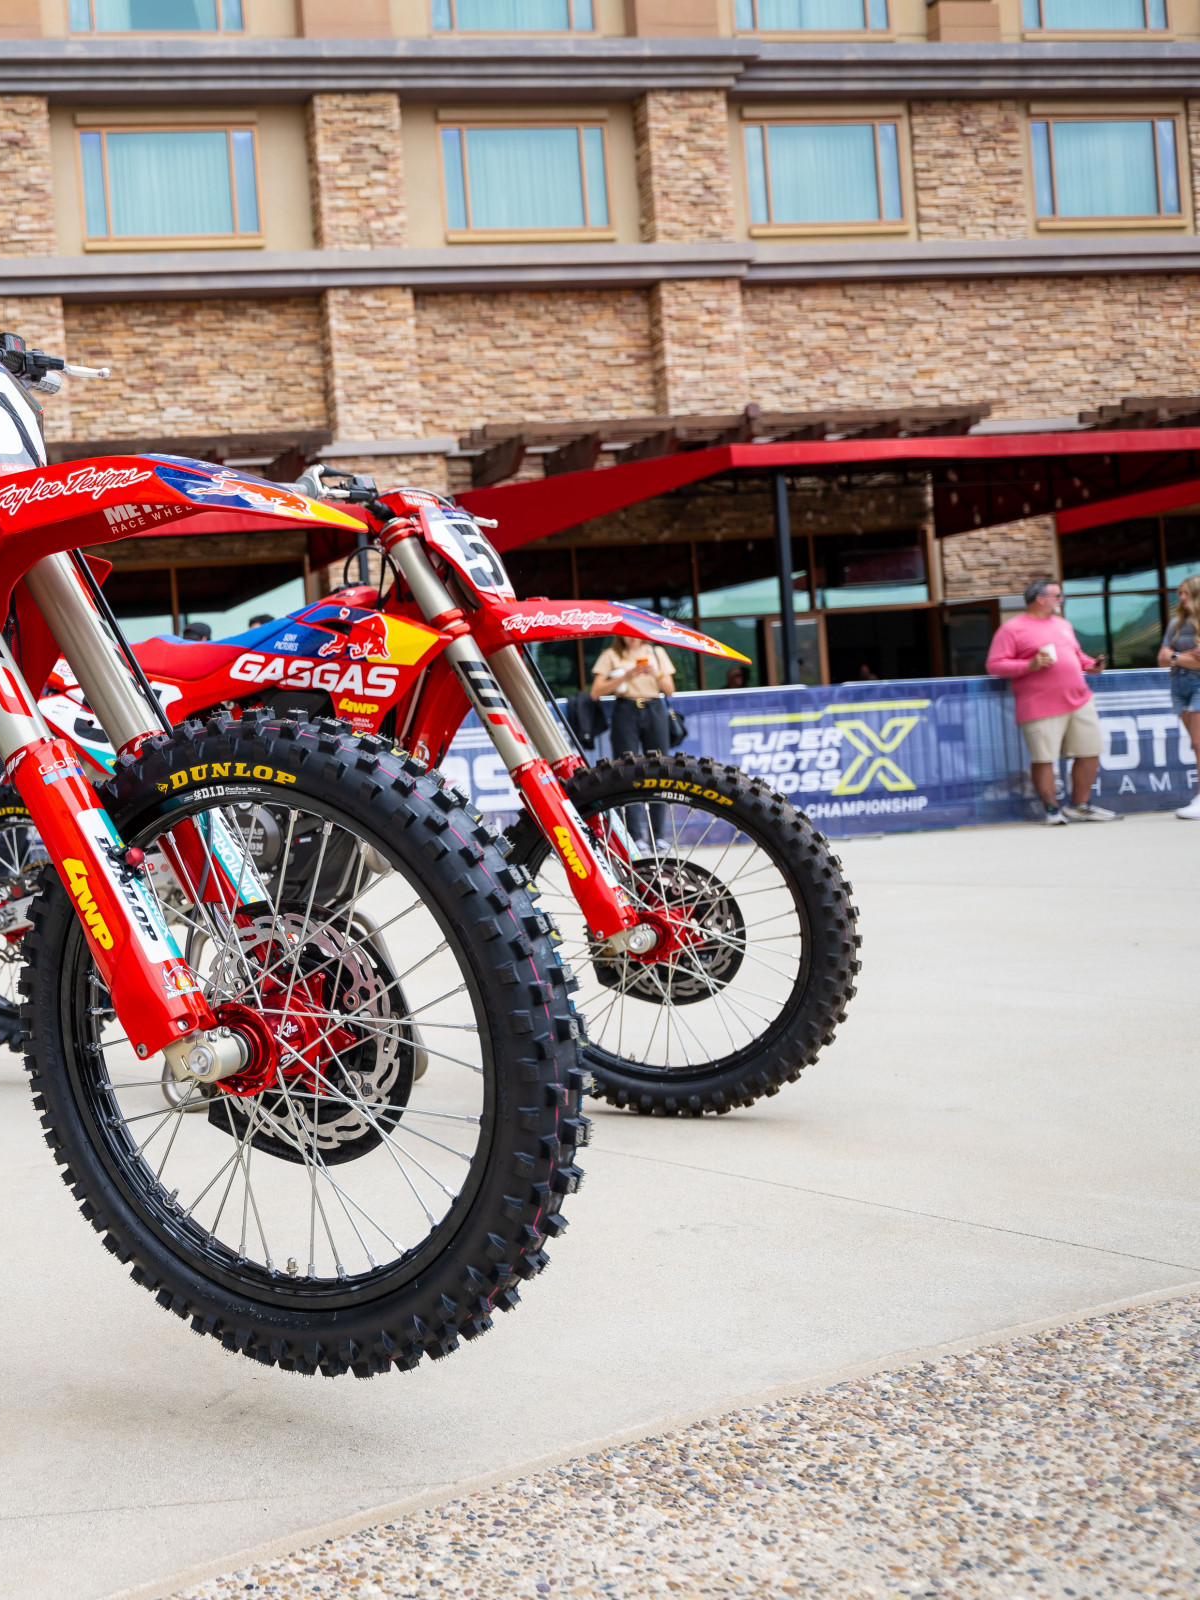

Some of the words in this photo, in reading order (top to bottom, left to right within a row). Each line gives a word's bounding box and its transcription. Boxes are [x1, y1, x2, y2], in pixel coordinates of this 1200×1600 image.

[111, 516, 146, 534] RACE
[230, 652, 400, 698] GASGAS
[730, 727, 844, 755] SUPER
[741, 748, 841, 774] MOTO
[170, 762, 297, 790] DUNLOP
[749, 769, 842, 796] ROSS
[642, 778, 734, 806] DUNLOP
[804, 795, 929, 820] CHAMPIONSHIP
